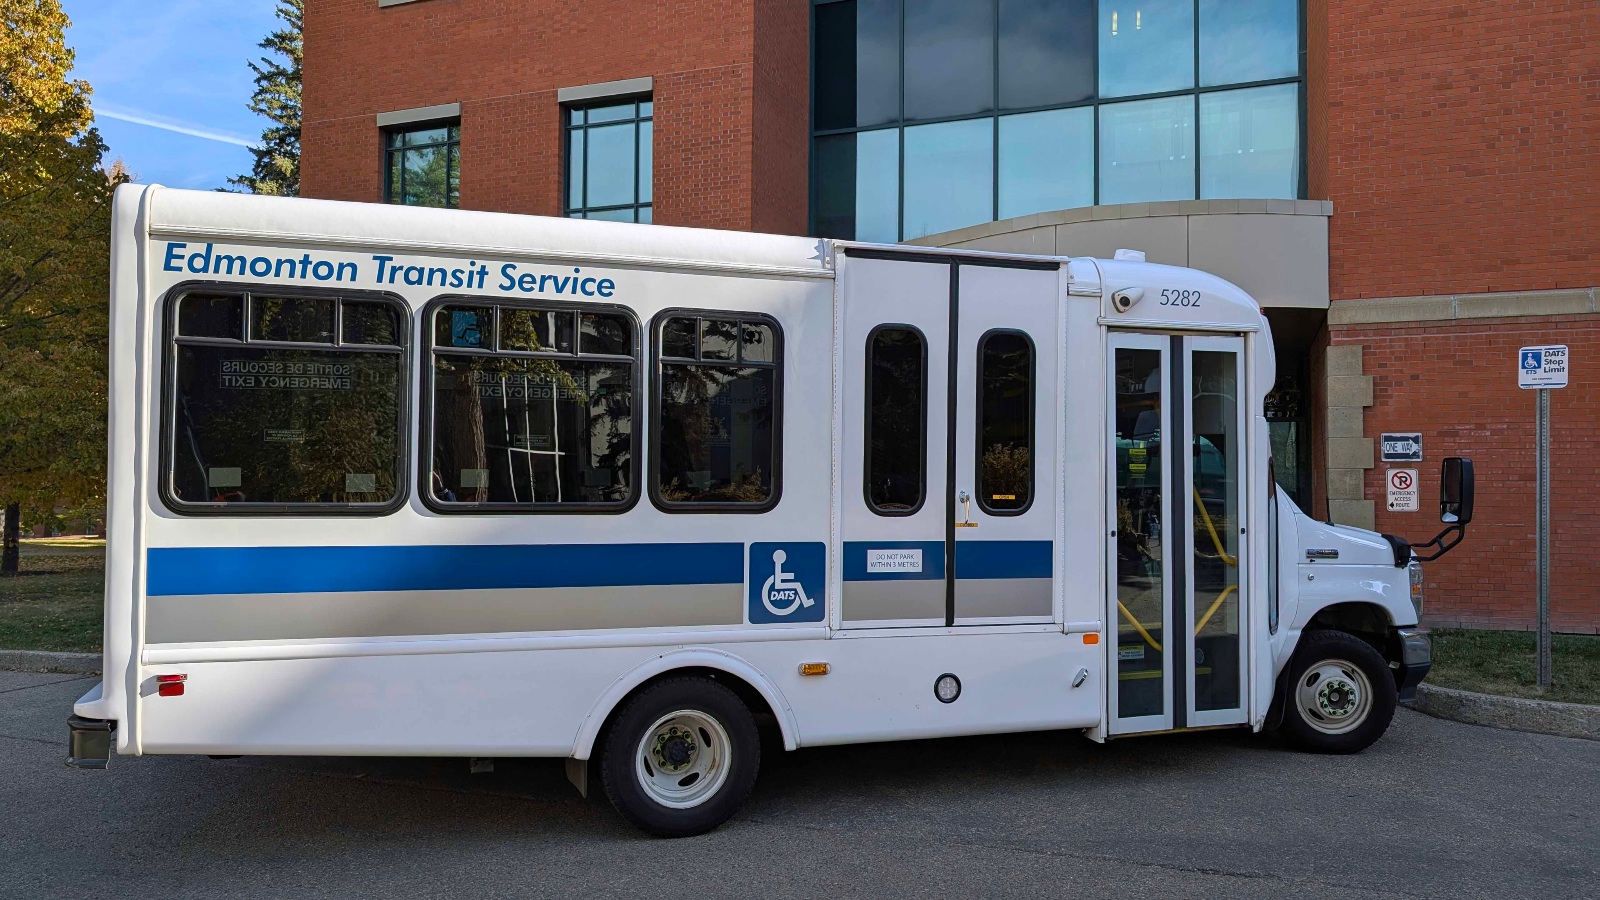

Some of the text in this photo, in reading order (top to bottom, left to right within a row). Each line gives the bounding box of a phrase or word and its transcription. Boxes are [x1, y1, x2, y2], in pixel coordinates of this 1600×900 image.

[162, 242, 616, 298] Edmonton Transit Service
[1159, 288, 1201, 307] 5282
[1543, 350, 1566, 358] DATS
[1543, 358, 1564, 366] Stop
[1385, 442, 1413, 452] ONE WAY
[770, 590, 795, 601] DATS
